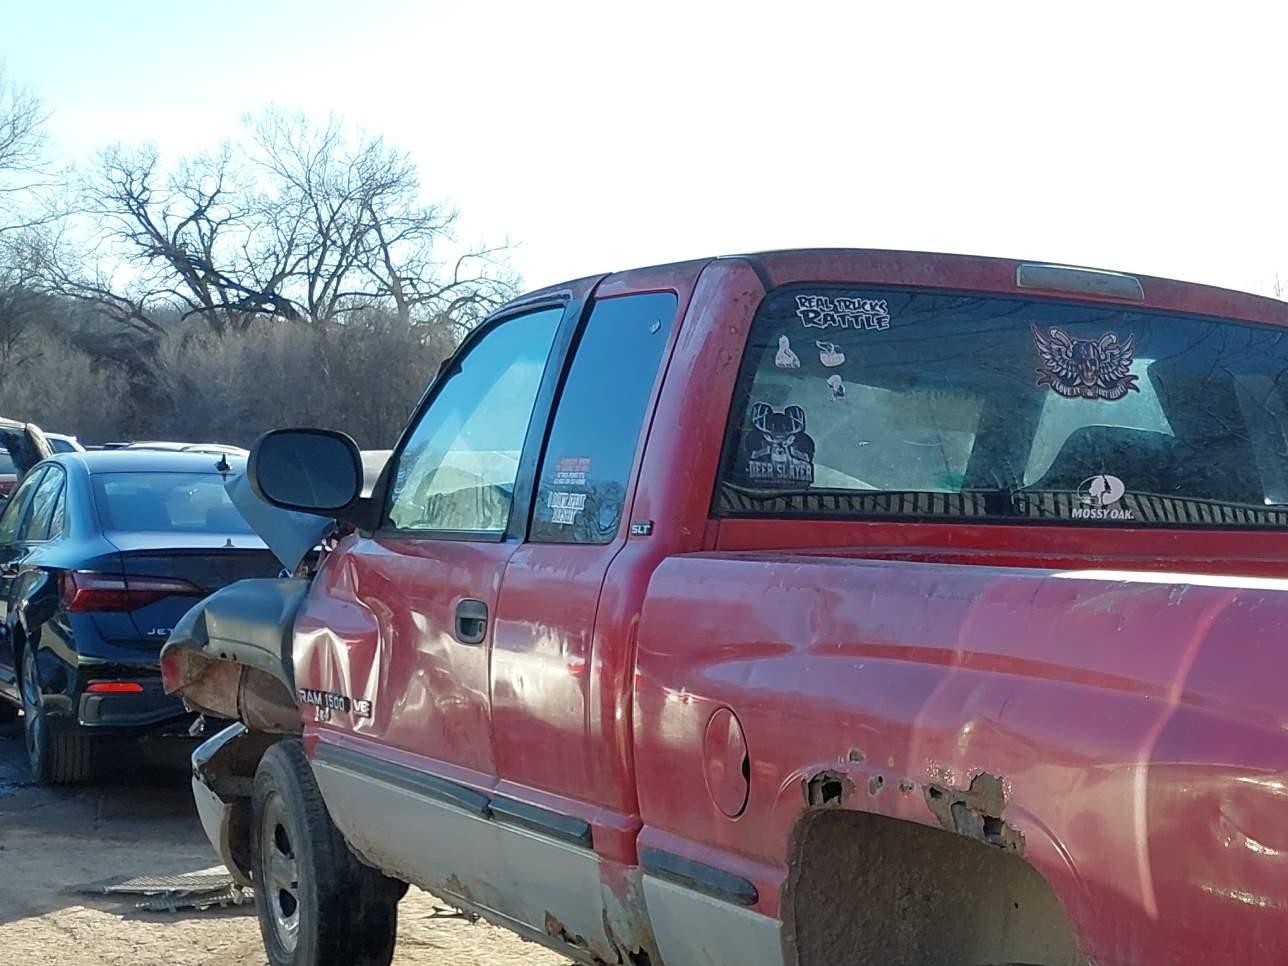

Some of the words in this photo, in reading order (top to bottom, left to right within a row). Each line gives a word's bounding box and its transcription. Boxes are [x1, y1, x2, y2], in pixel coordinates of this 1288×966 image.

[796, 295, 833, 311] REAL
[835, 298, 887, 314] TRUCKS
[797, 309, 890, 330] RATTLE
[749, 461, 774, 478] DEER
[776, 463, 812, 481] SLAYER
[1071, 508, 1110, 519] MOSSY
[631, 524, 651, 534] SLT
[147, 628, 175, 636] JET
[299, 690, 322, 705] RAM
[324, 693, 345, 711] 1500
